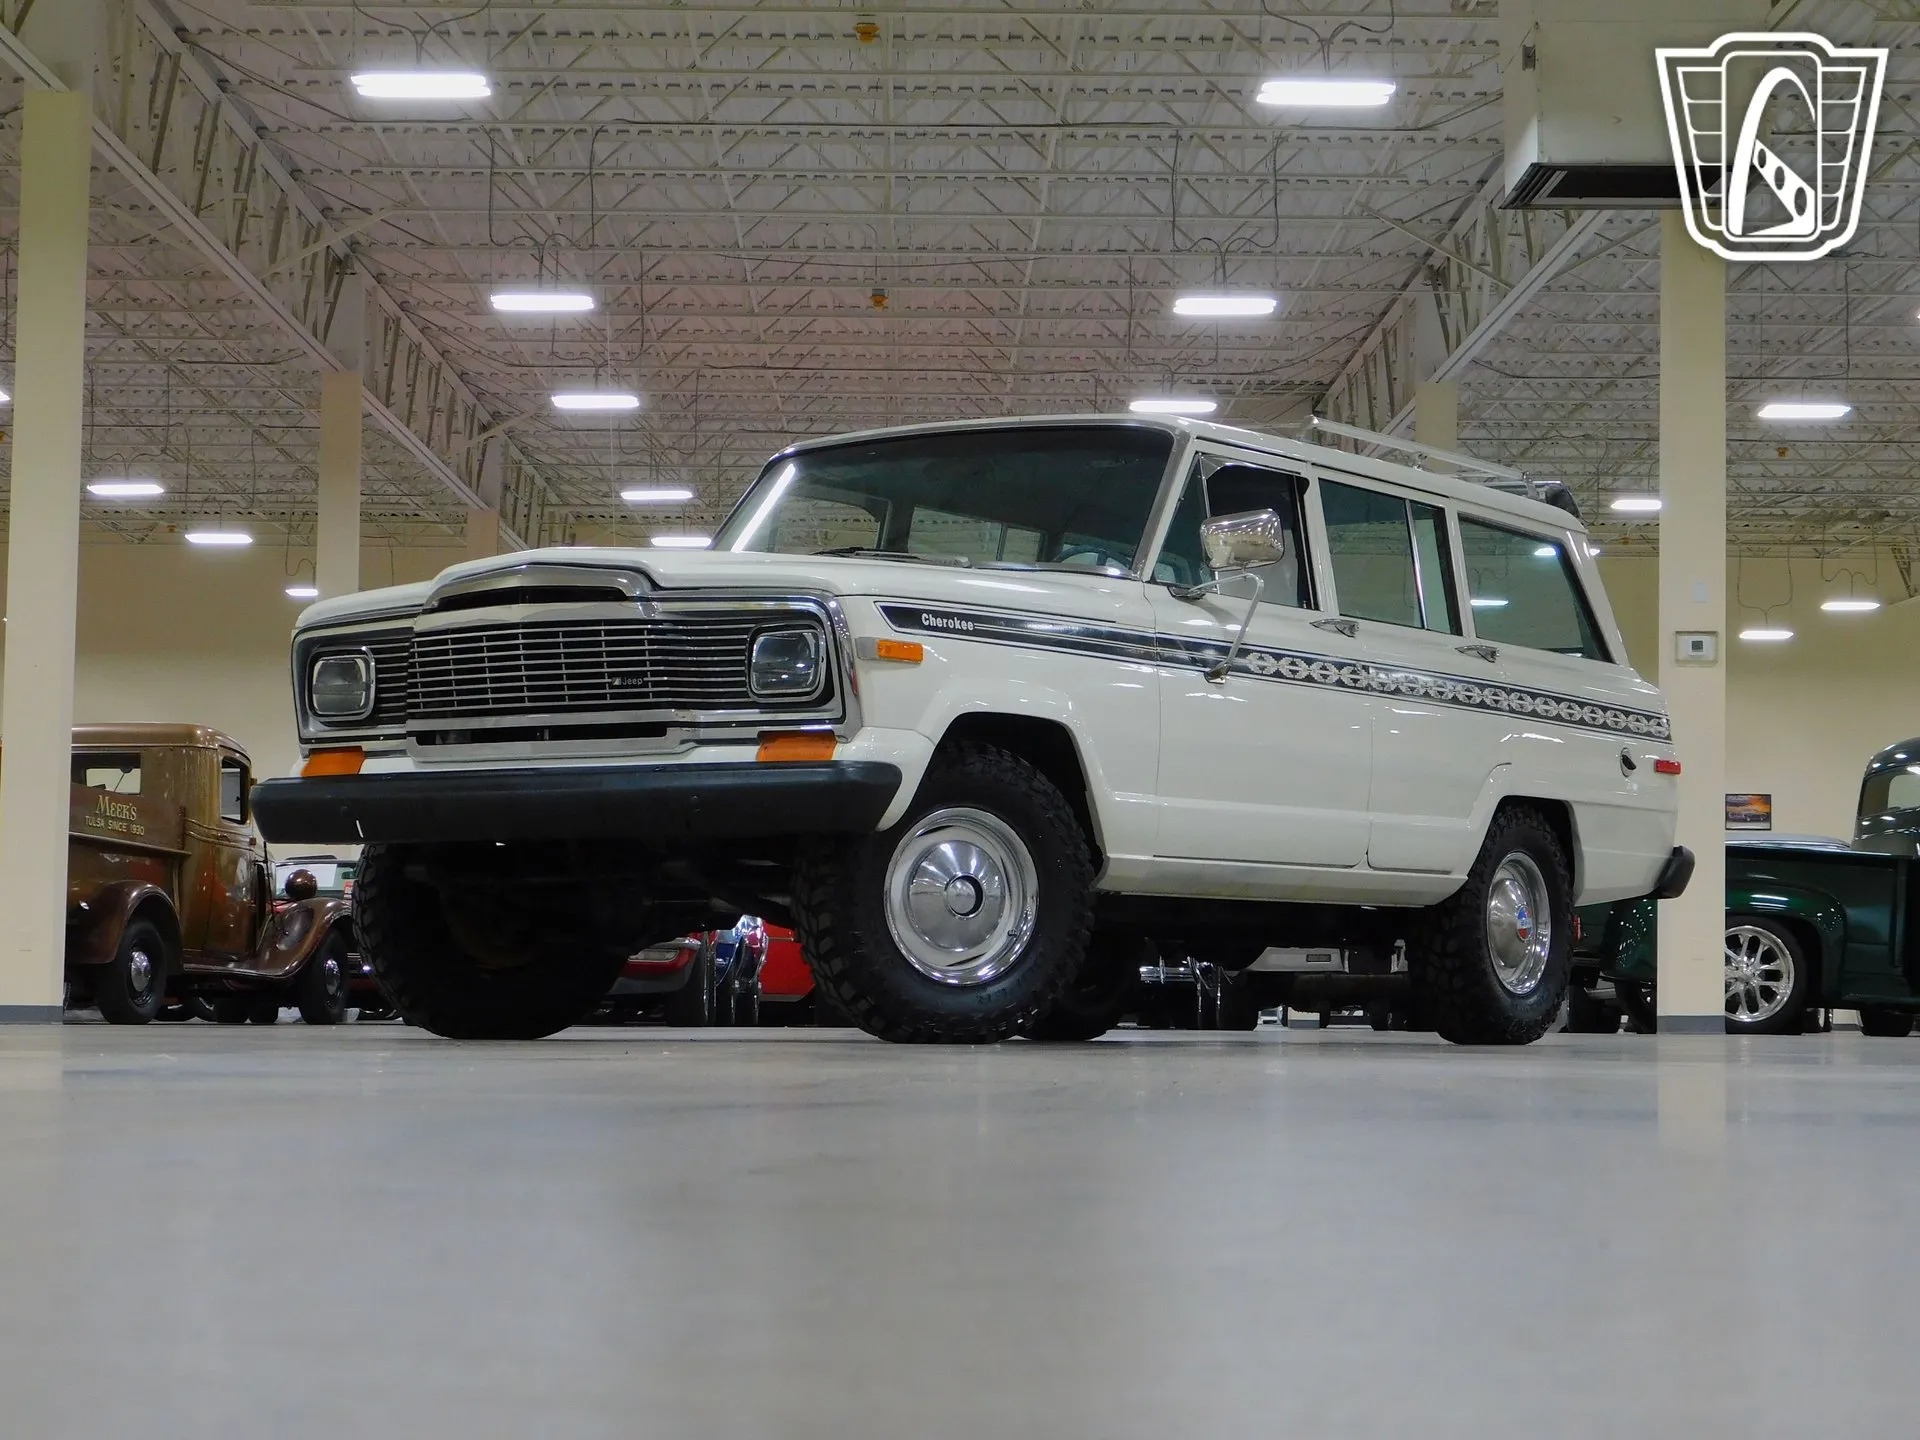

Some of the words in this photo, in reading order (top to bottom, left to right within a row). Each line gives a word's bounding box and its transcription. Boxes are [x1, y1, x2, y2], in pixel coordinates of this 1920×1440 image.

[921, 612, 974, 631] Cherokee
[622, 677, 643, 686] Jeep
[84, 815, 105, 829] TULSA
[107, 819, 128, 832] SINCE
[130, 823, 145, 836] 1930
